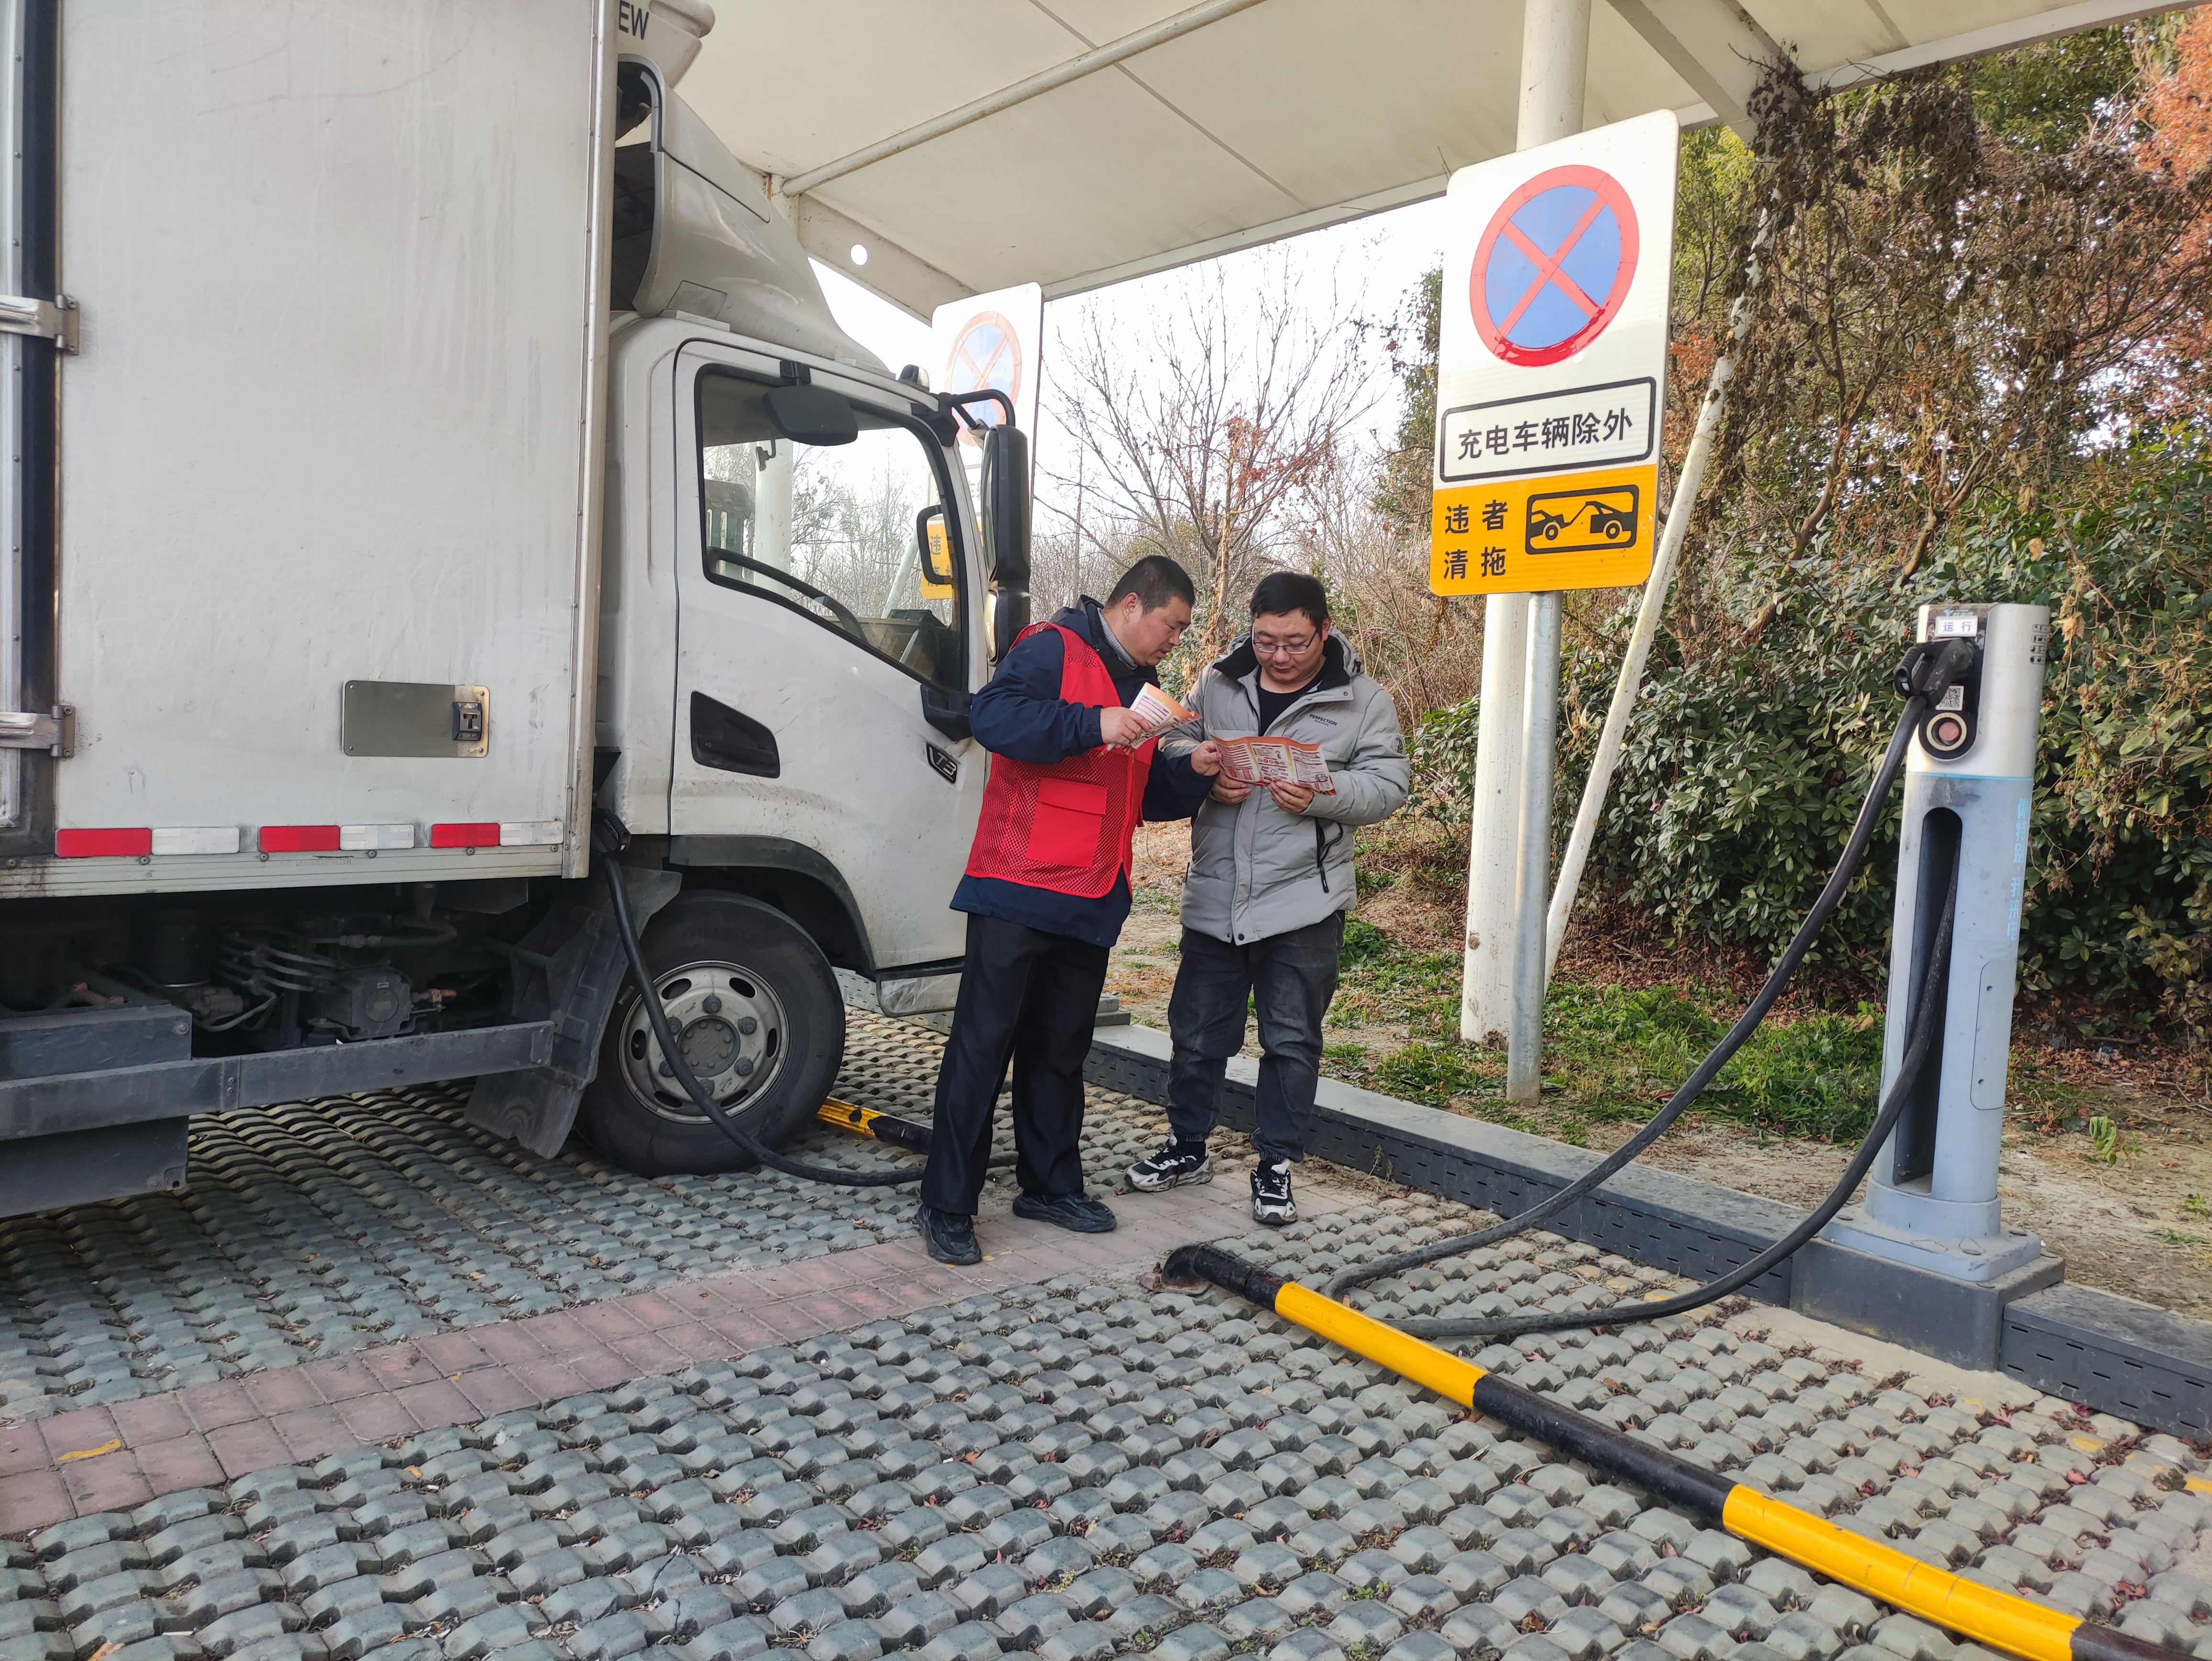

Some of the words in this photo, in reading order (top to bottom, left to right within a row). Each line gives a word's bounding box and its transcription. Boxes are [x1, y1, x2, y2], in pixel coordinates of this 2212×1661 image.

[1458, 408, 1633, 461] 充电车辆除外
[1445, 499, 1508, 534] 违者
[1443, 546, 1506, 580] 清拖
[1943, 621, 1972, 632] 运行
[1309, 714, 1338, 726] PERFECTION
[935, 751, 957, 775] T3
